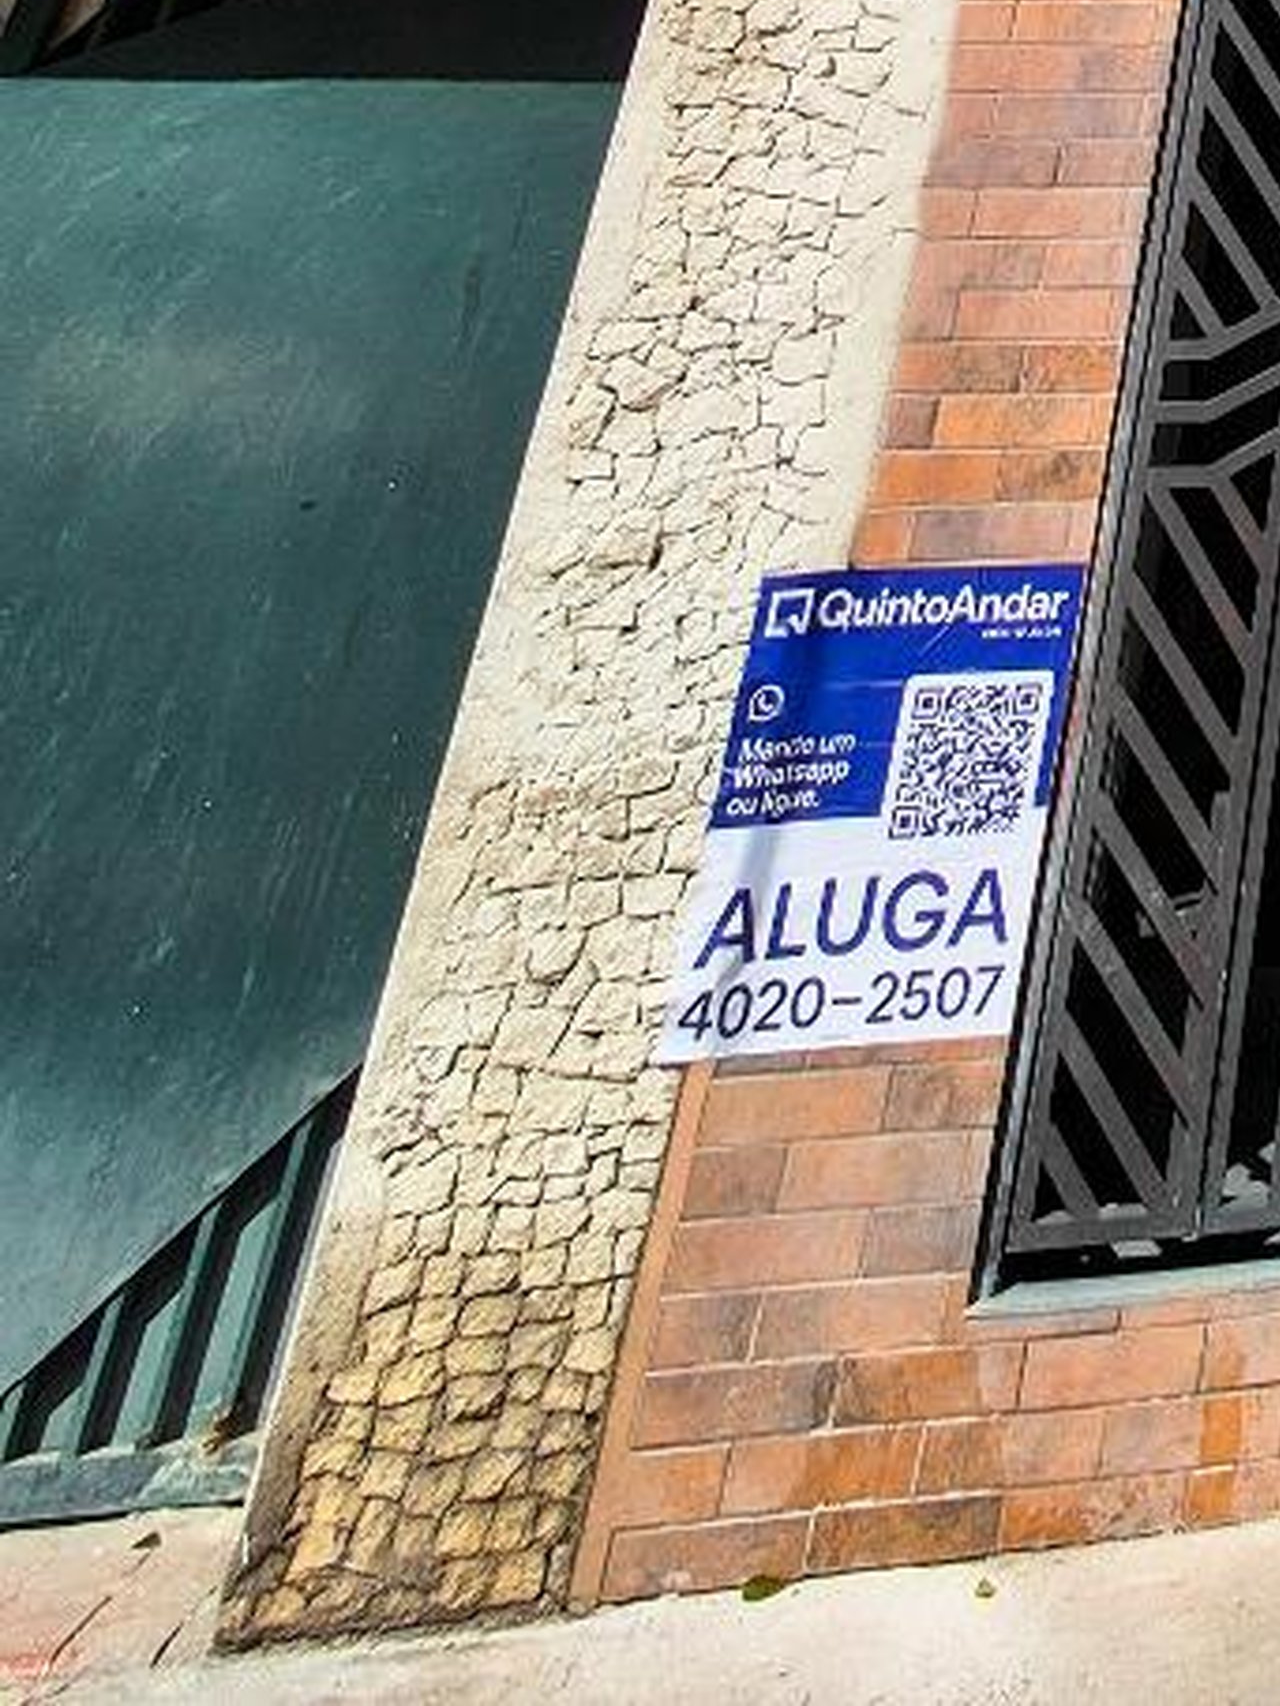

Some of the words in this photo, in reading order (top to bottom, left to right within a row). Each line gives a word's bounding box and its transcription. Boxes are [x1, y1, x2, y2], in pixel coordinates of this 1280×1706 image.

[818, 584, 1070, 632] QuintoAndar
[819, 733, 857, 756] um
[725, 795, 761, 817] ou
[692, 868, 1009, 970] ALUGA
[677, 964, 1006, 1042] 4020-2507
